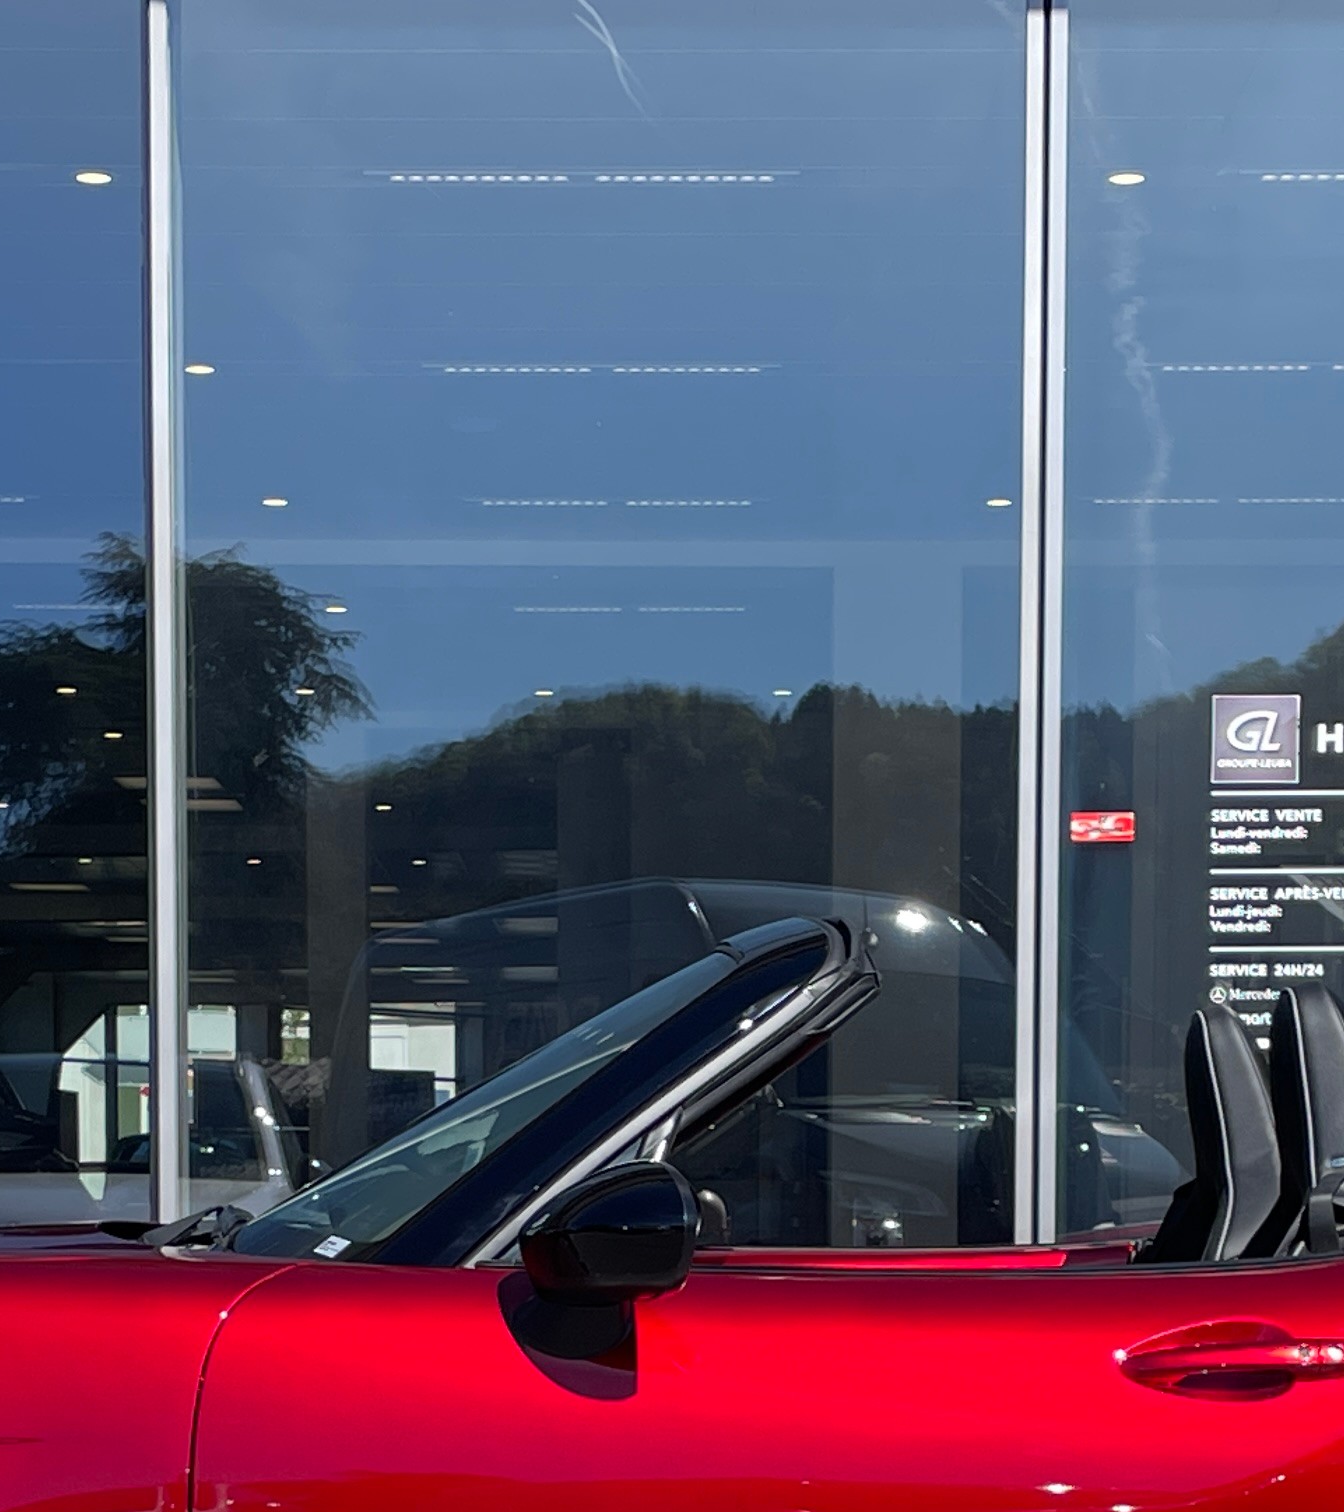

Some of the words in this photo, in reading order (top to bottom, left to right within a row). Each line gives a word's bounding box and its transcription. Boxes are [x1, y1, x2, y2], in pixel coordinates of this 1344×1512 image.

[1210, 808, 1269, 823] SERVICE
[1274, 808, 1323, 823] VENTE
[1209, 886, 1269, 901] SERVICE
[1209, 963, 1268, 977] SERVICE
[1273, 963, 1325, 977] 24H/24
[1229, 987, 1281, 1001] Mercede
